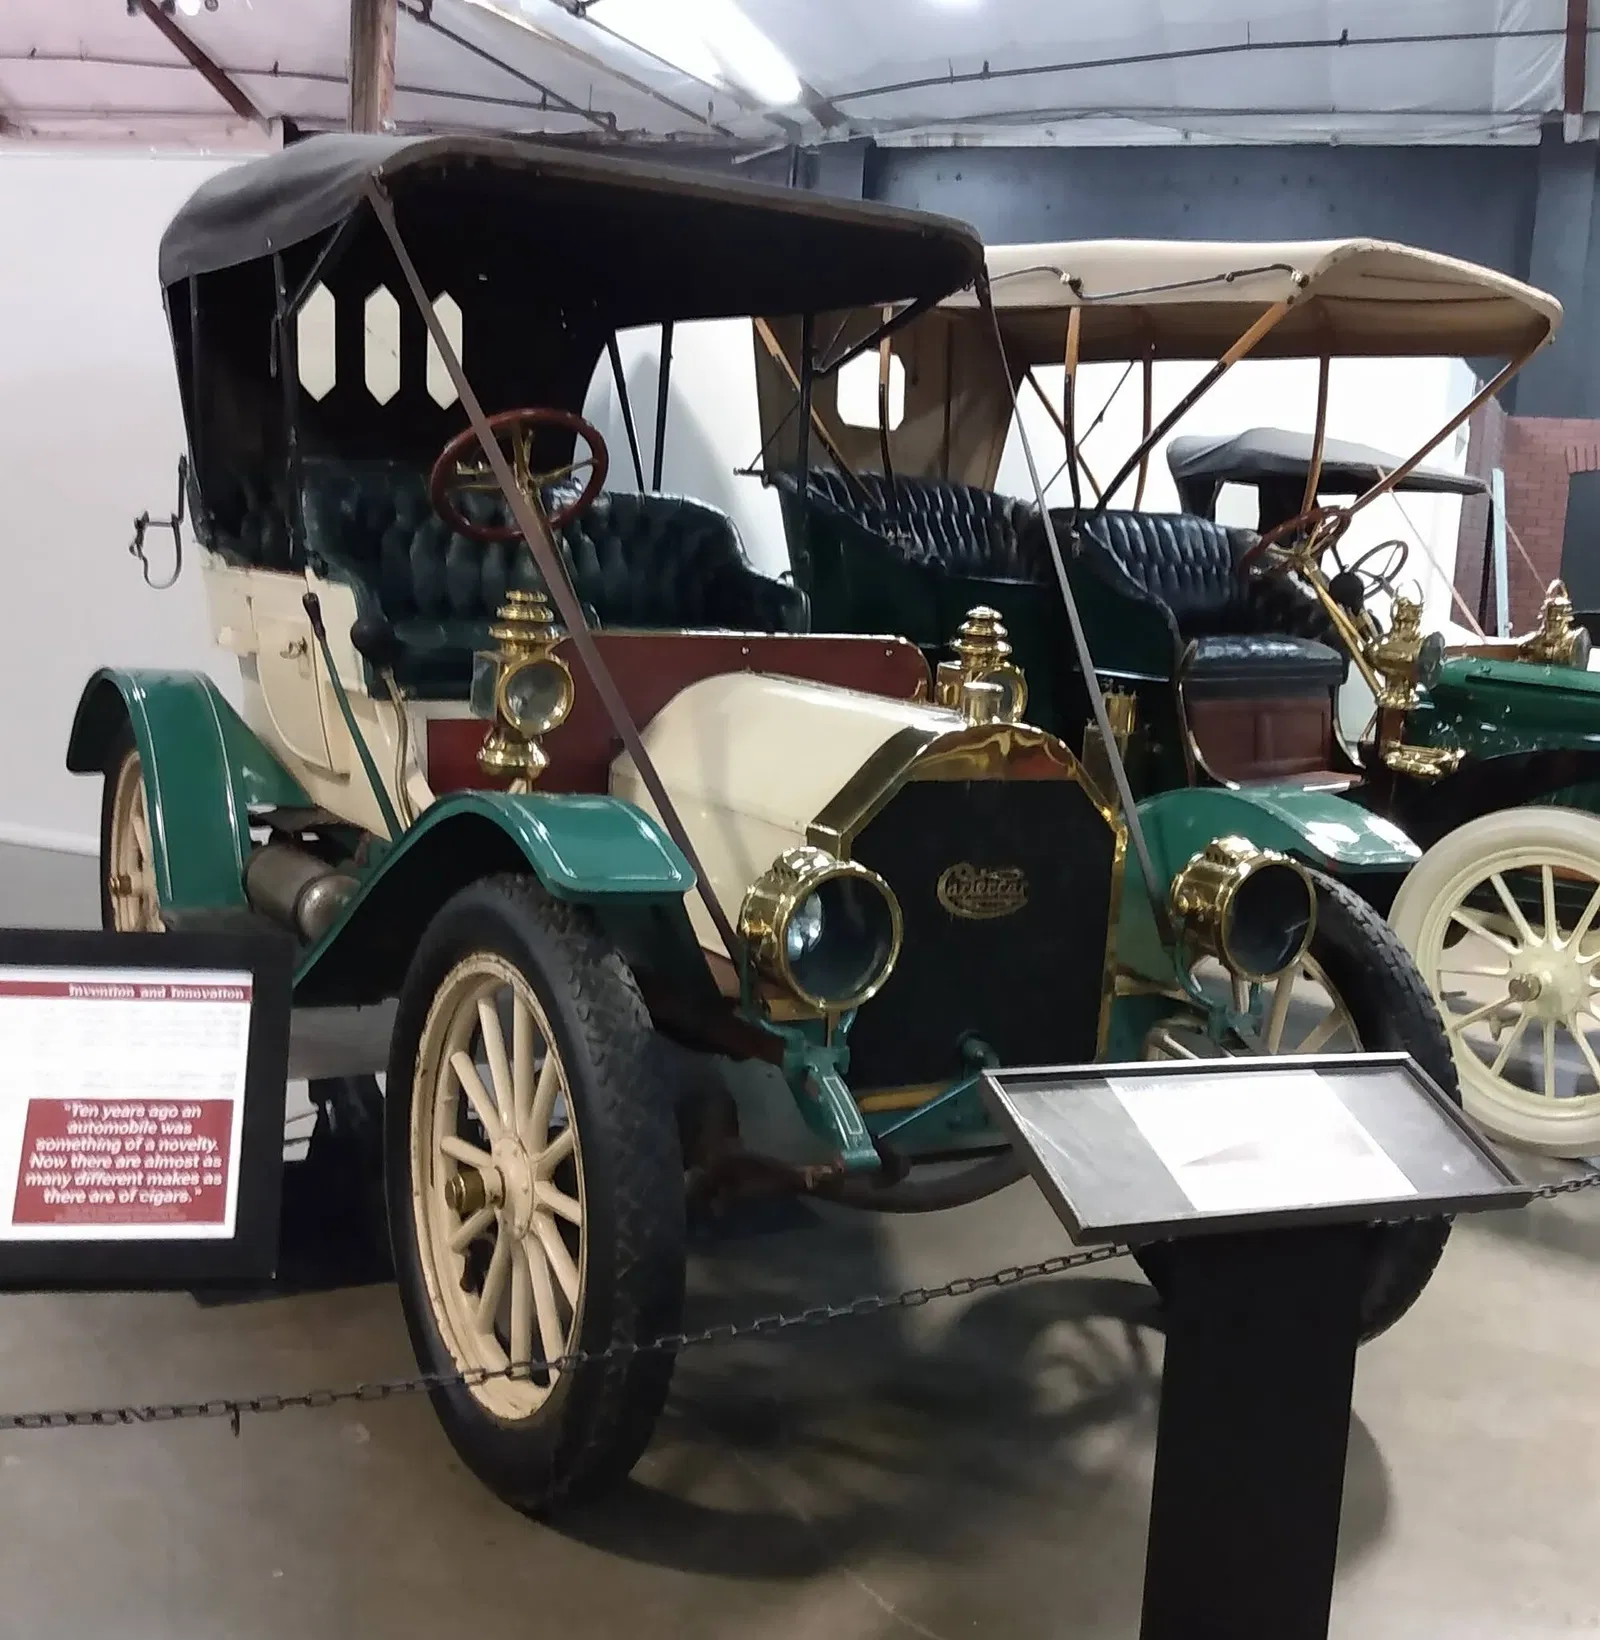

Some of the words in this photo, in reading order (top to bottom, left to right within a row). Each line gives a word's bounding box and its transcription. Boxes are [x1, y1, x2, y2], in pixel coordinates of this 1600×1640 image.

[69, 983, 134, 997] Invention
[140, 986, 165, 997] and
[171, 987, 244, 999] Innovation
[102, 1106, 145, 1120] years
[149, 1106, 178, 1120] ago
[182, 1106, 201, 1118] an
[67, 1120, 157, 1135] automobile
[161, 1123, 192, 1135] was
[36, 1137, 121, 1154] something
[125, 1137, 143, 1151] of
[145, 1139, 155, 1151] a
[159, 1136, 218, 1153] novelty.
[30, 1154, 67, 1169] Now
[71, 1153, 111, 1169] there
[115, 1156, 140, 1169] are
[144, 1153, 199, 1169] almost
[203, 1156, 222, 1168] as
[24, 1172, 71, 1189] many
[74, 1171, 144, 1186] different
[147, 1171, 199, 1186] makes
[203, 1173, 222, 1186] as
[44, 1188, 85, 1204] there
[89, 1191, 115, 1204] are
[119, 1188, 137, 1204] of
